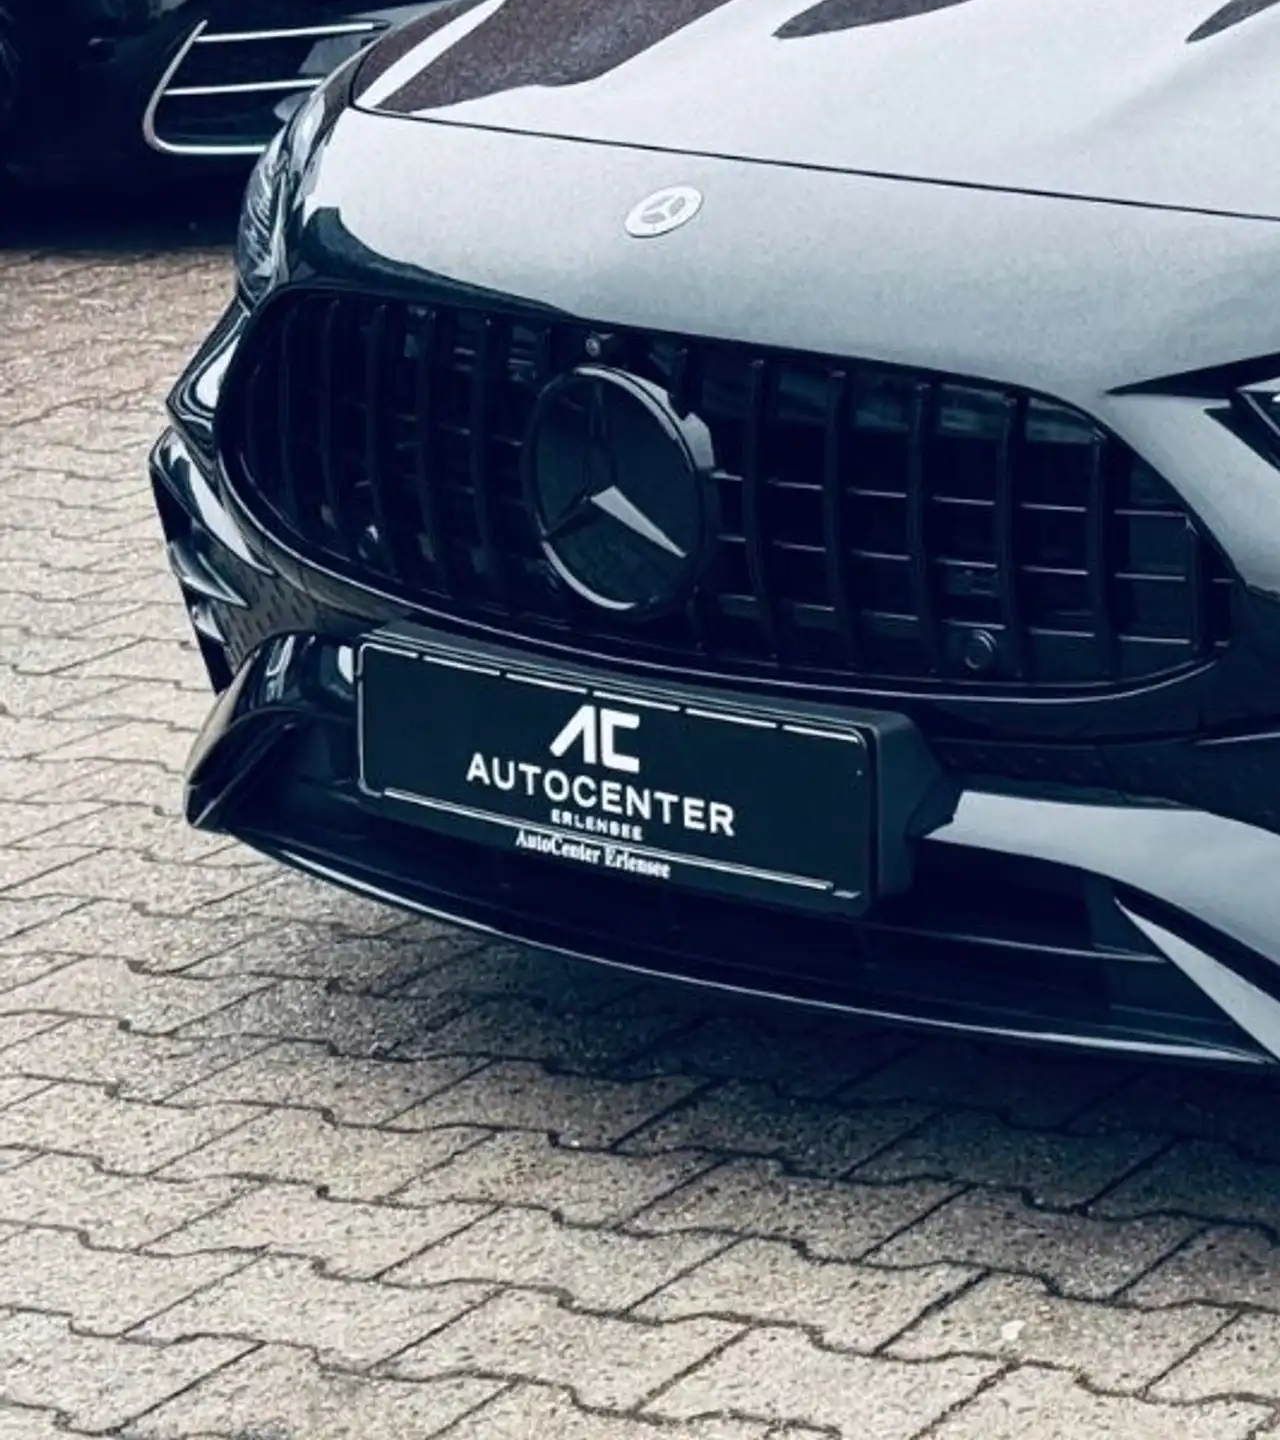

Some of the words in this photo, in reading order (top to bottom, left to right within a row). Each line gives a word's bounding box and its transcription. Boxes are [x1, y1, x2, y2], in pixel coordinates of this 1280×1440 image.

[466, 752, 736, 837] AUTOCENTER
[551, 808, 643, 841] ERLENSEE
[515, 829, 601, 864] AutoCenter
[604, 845, 671, 879] Erlensee
